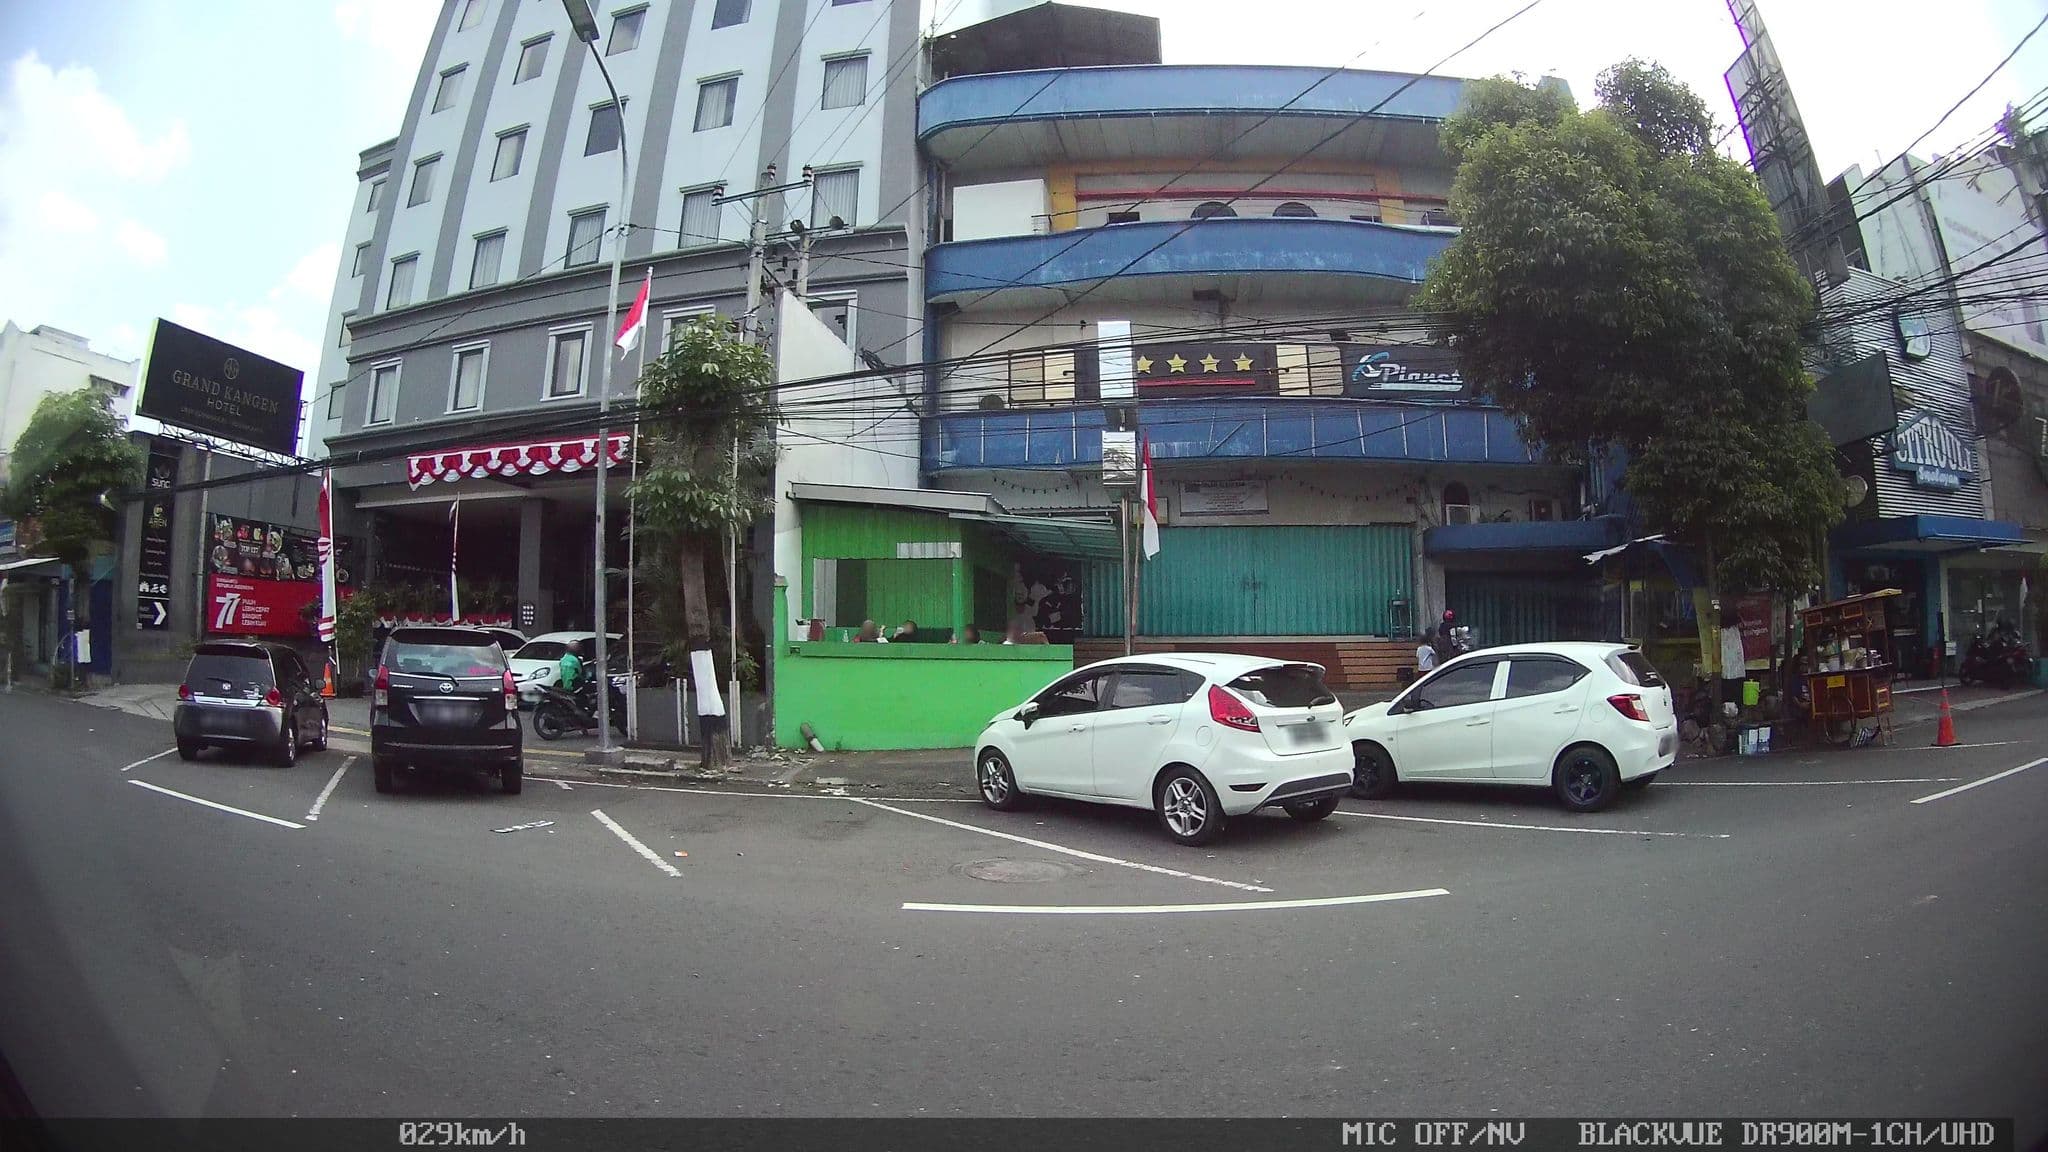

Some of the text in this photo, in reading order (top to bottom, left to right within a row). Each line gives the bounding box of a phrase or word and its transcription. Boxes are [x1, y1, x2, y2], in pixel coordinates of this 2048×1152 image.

[173, 369, 280, 414] GRAND KANGEN
[207, 398, 241, 416] HOTEL
[215, 592, 241, 629] 77
